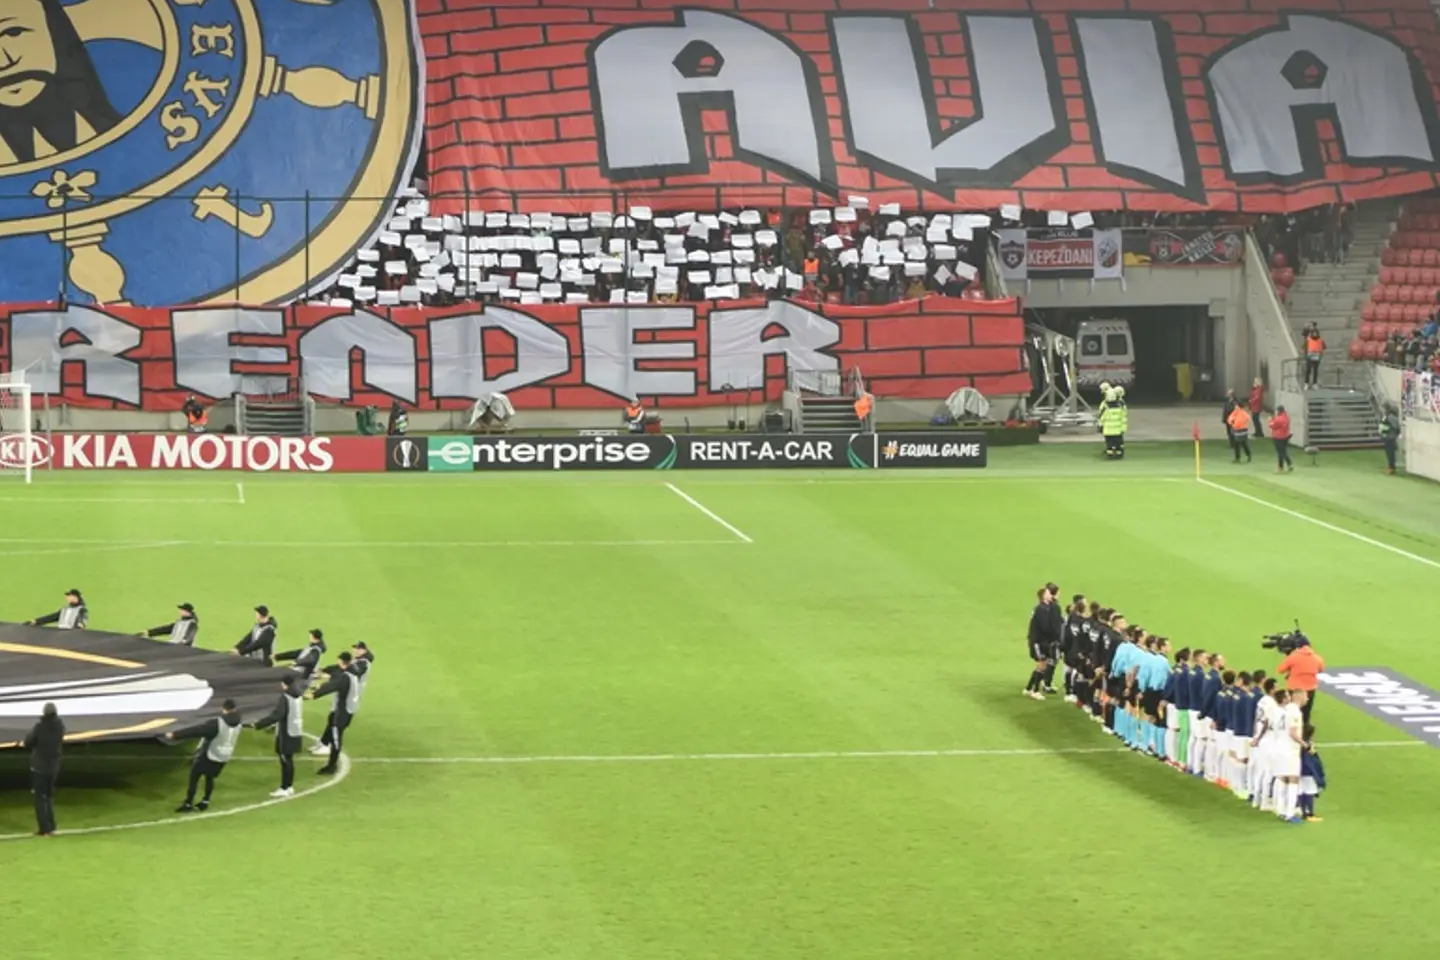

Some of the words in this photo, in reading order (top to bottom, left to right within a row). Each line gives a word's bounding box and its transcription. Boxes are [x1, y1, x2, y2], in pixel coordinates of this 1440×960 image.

[63, 435, 137, 468] KIA
[151, 435, 334, 471] MOTORS
[429, 437, 651, 469] enterprise
[690, 441, 834, 461] RENT-A-CAR
